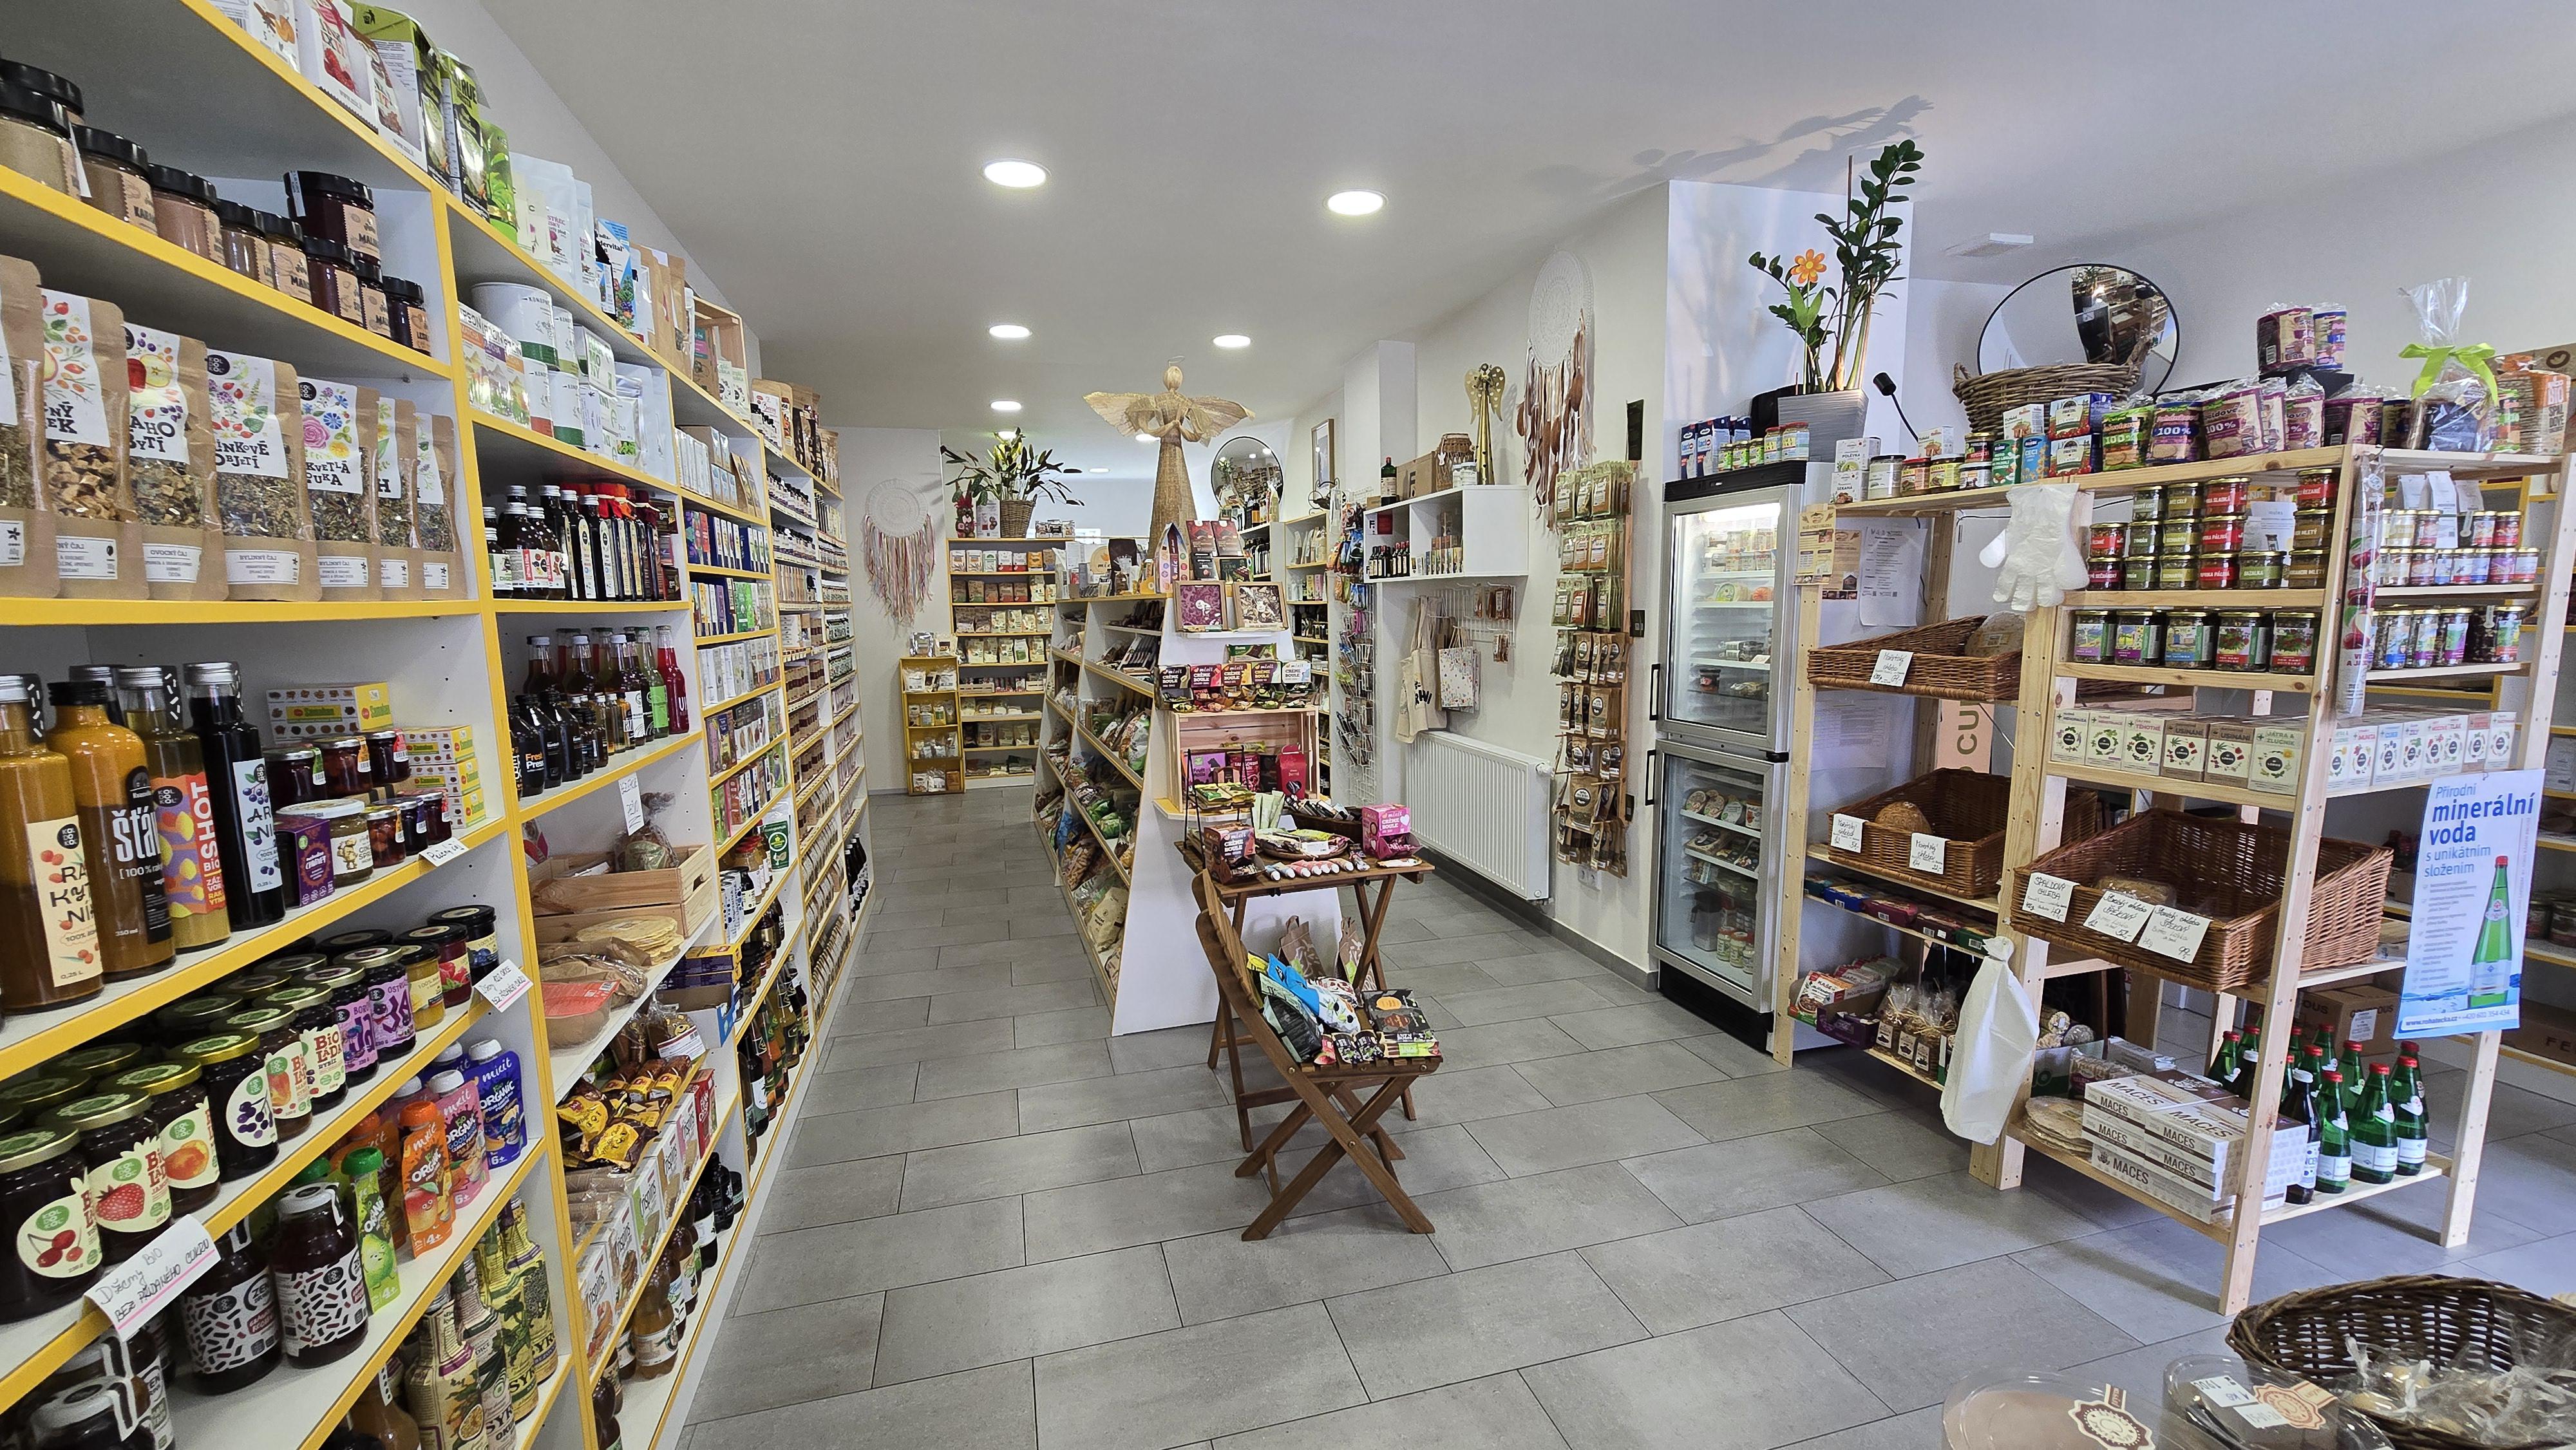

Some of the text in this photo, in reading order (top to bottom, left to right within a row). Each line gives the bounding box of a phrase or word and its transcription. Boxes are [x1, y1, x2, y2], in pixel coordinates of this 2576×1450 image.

[44, 401, 74, 418] NÝ
[46, 418, 77, 434] EK
[130, 416, 175, 437] AHO
[307, 460, 350, 474] KVETLÁ
[2436, 783, 2477, 799] Přírodní
[2432, 793, 2535, 822] minerální
[191, 782, 218, 858] SHOT
[2429, 820, 2477, 845] voda
[2426, 843, 2491, 862] s unikátním
[2424, 861, 2474, 878] složením
[2037, 887, 2061, 900] CHLEBA
[316, 1044, 342, 1064] LÁDA
[2101, 1096, 2128, 1116] MACES
[2099, 1124, 2128, 1145] MACES
[2163, 1127, 2195, 1149] MACES
[491, 1156, 504, 1165] 6+
[2164, 1154, 2196, 1176] MACES
[2113, 1158, 2149, 1184] MACES
[426, 1233, 441, 1245] 4+
[115, 1300, 136, 1323] BEZ
[185, 1238, 209, 1265] CUKRU
